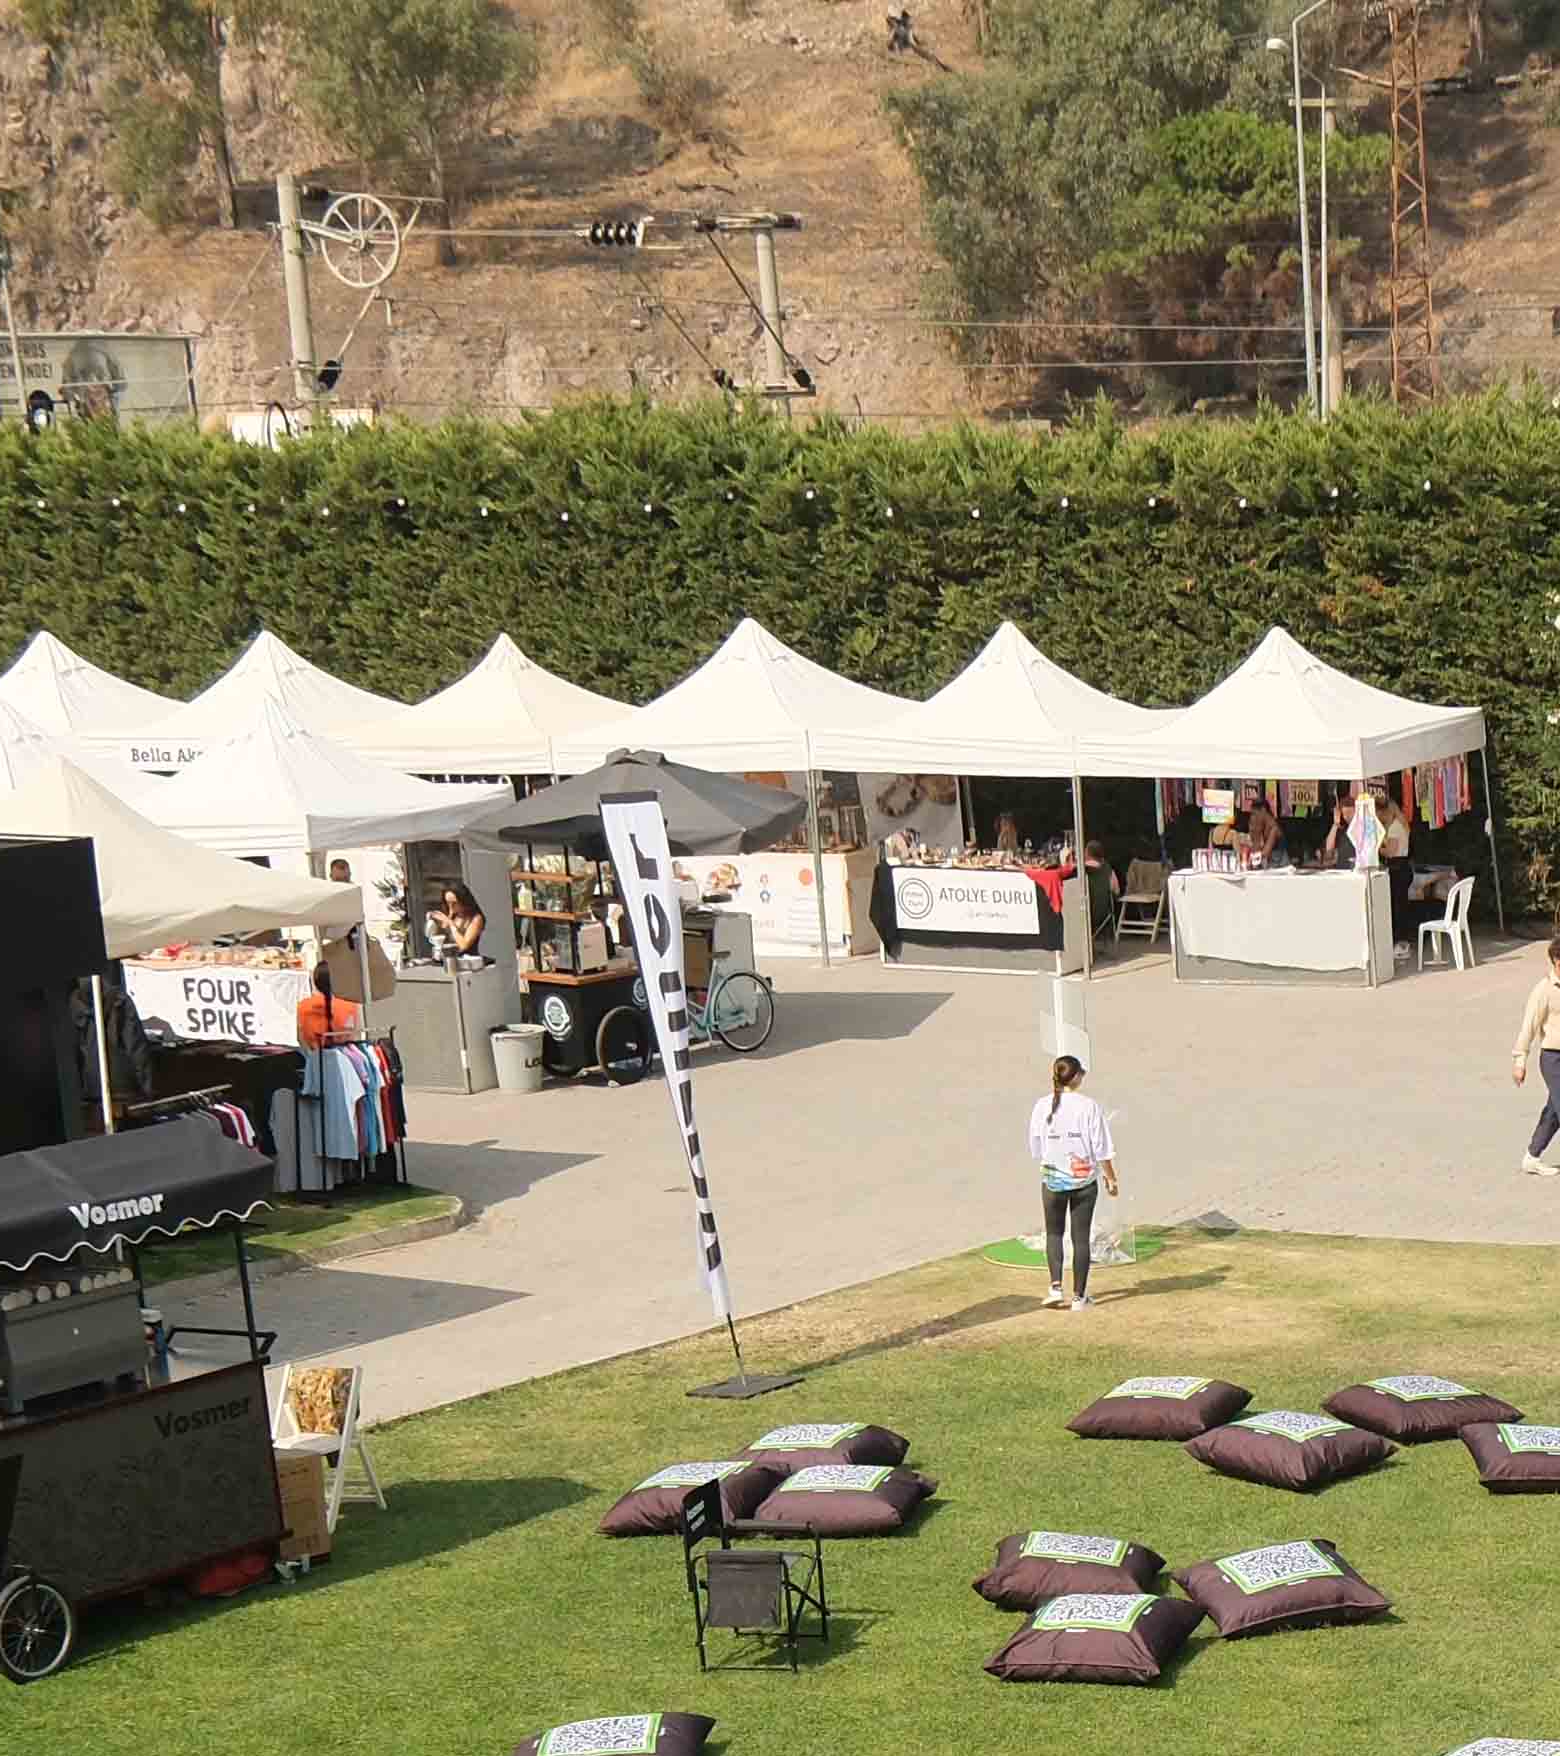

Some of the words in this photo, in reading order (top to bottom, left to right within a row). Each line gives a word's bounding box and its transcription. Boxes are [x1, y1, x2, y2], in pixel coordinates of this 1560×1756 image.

[130, 747, 172, 763] Bella
[992, 889, 1033, 905] DURU
[183, 977, 253, 1006] FOUR
[186, 1007, 256, 1044] SPIKE
[69, 1191, 164, 1229] Vosmer
[154, 1396, 252, 1440] Vosmer
